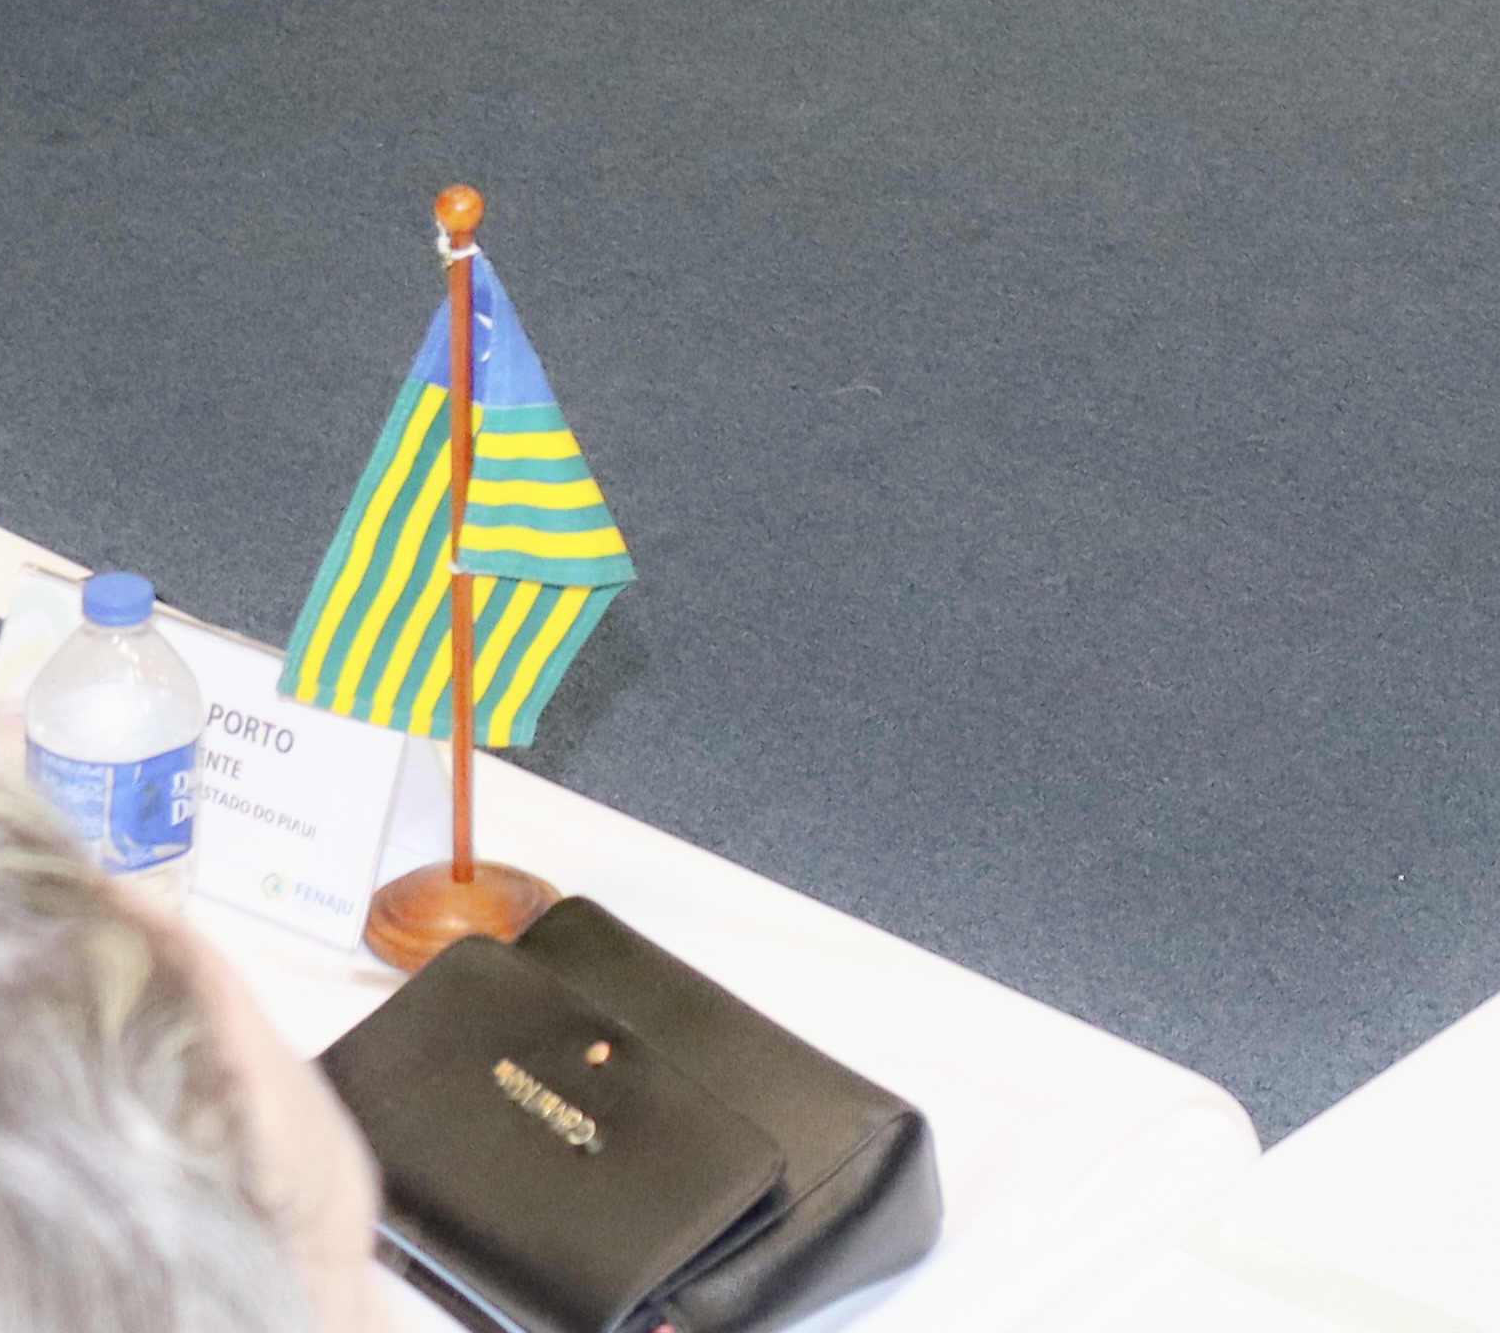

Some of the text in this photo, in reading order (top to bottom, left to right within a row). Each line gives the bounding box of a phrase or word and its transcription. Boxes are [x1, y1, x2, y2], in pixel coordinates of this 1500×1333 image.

[204, 702, 295, 755] PORTO
[252, 803, 277, 825] DO
[293, 881, 355, 918] FENAJU
